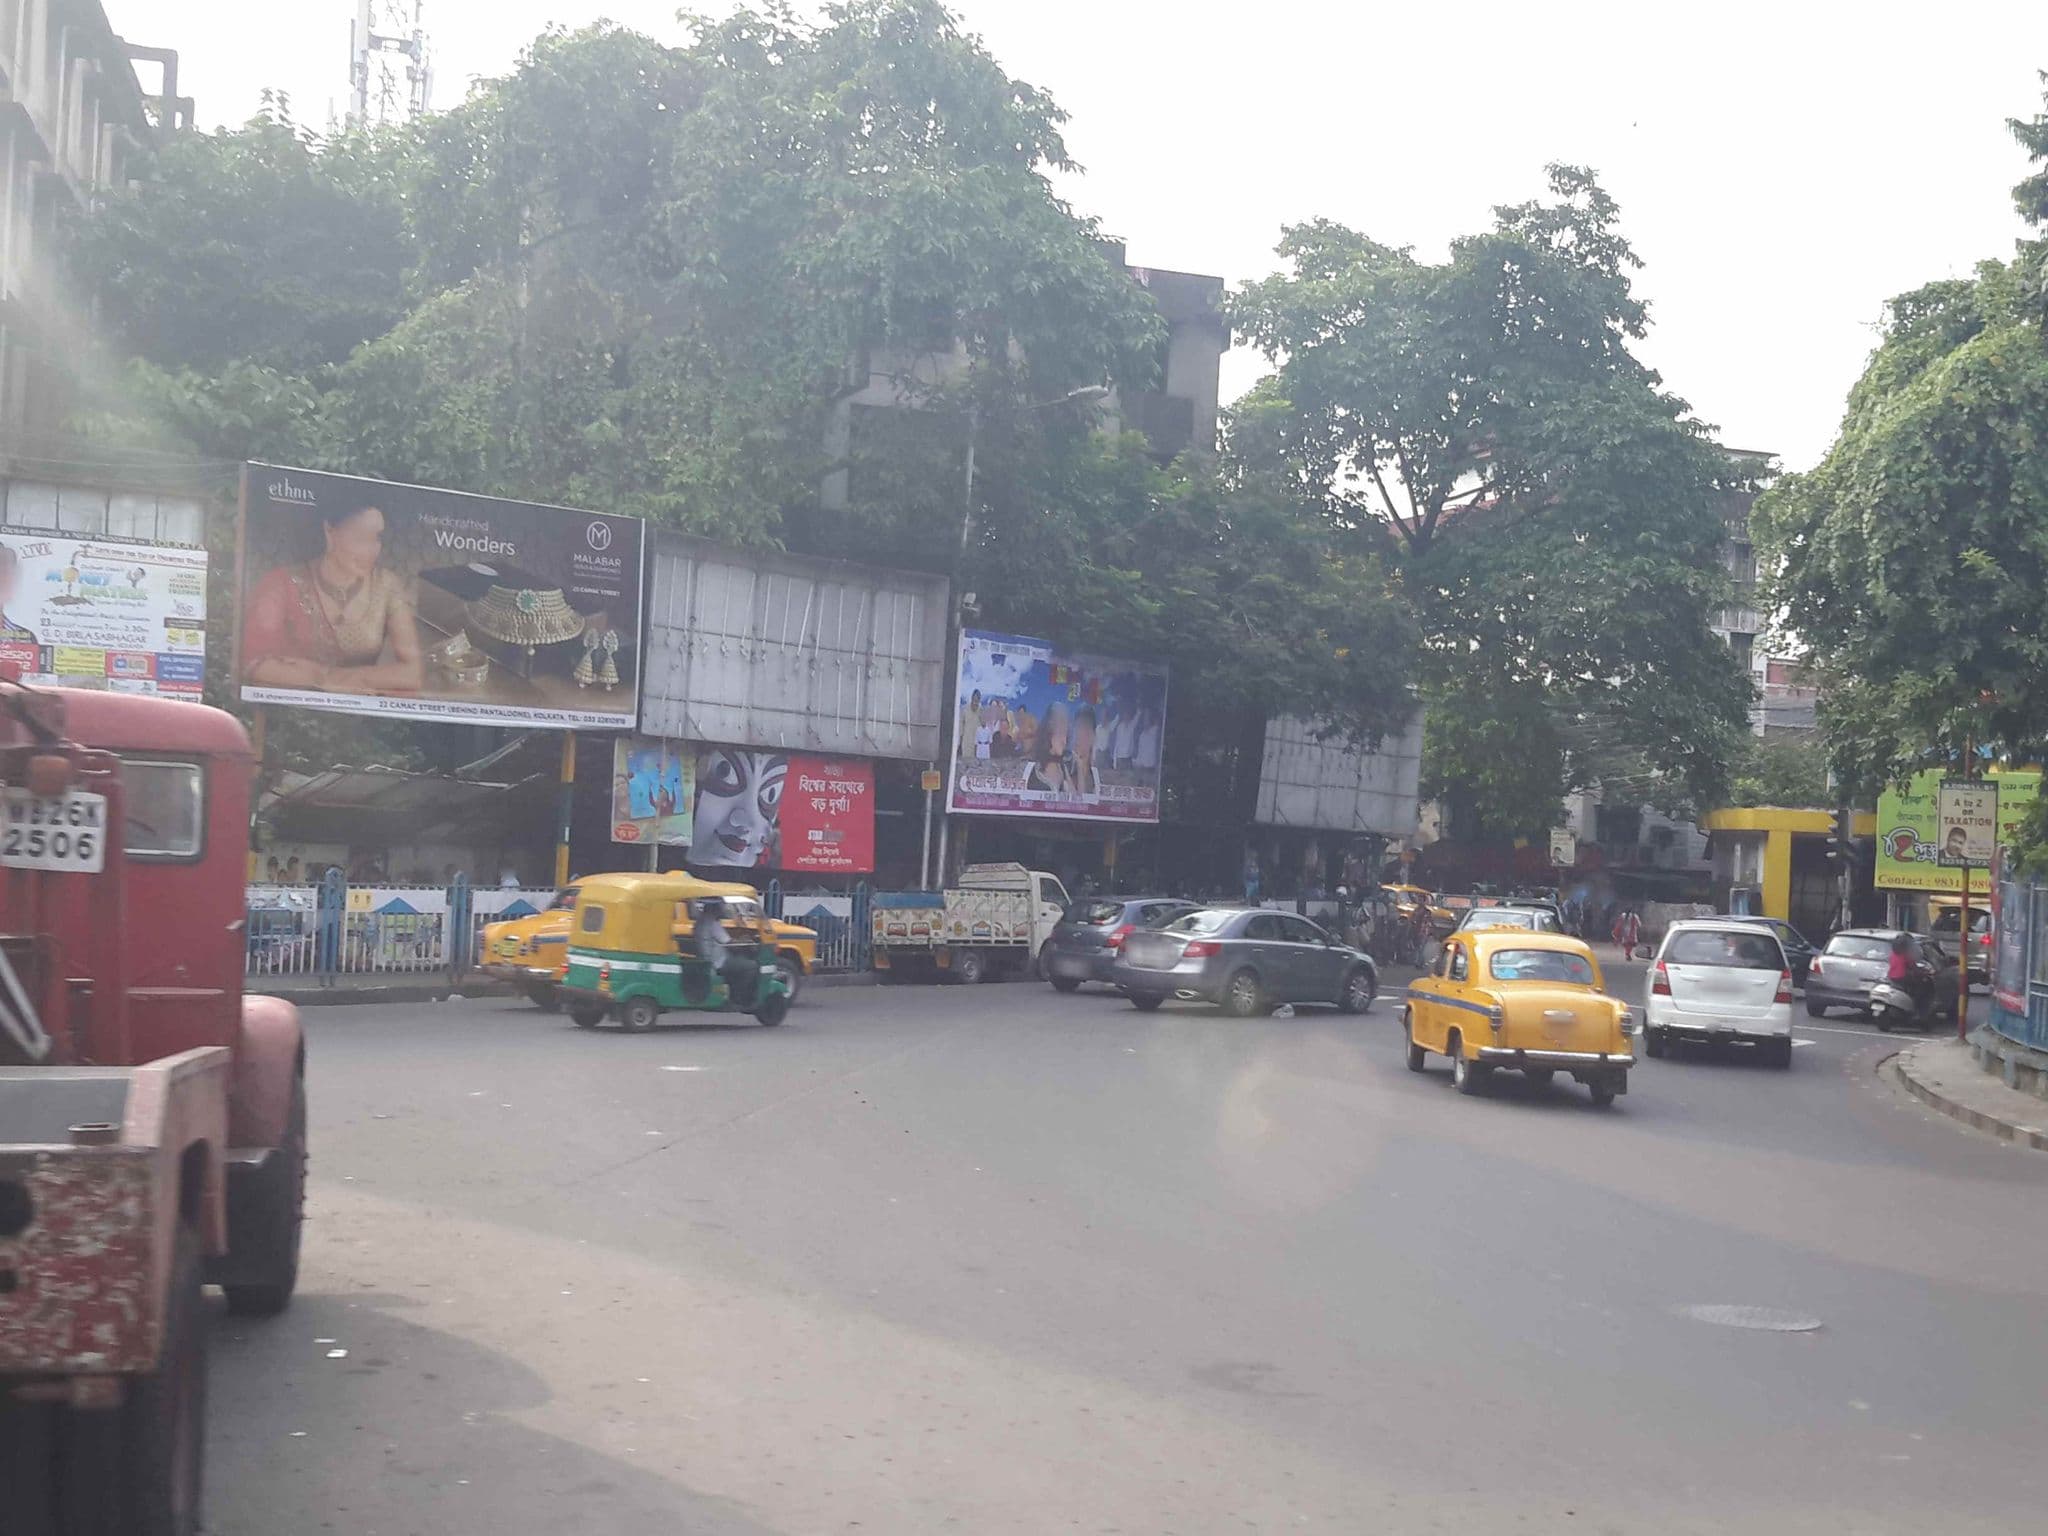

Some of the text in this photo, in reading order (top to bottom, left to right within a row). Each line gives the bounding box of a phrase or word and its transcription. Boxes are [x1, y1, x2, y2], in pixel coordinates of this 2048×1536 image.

[434, 530, 516, 556] Wonders
[574, 553, 621, 567] MALABAR
[389, 701, 416, 710] CAMAC
[419, 703, 446, 713] STREET
[800, 775, 826, 793] বিশ্বের
[811, 797, 827, 813] বড়
[1954, 799, 1983, 808] A to Z
[1944, 817, 1993, 826] TAXATION
[3, 829, 96, 860] 2506
[1878, 873, 1923, 886] Contact
